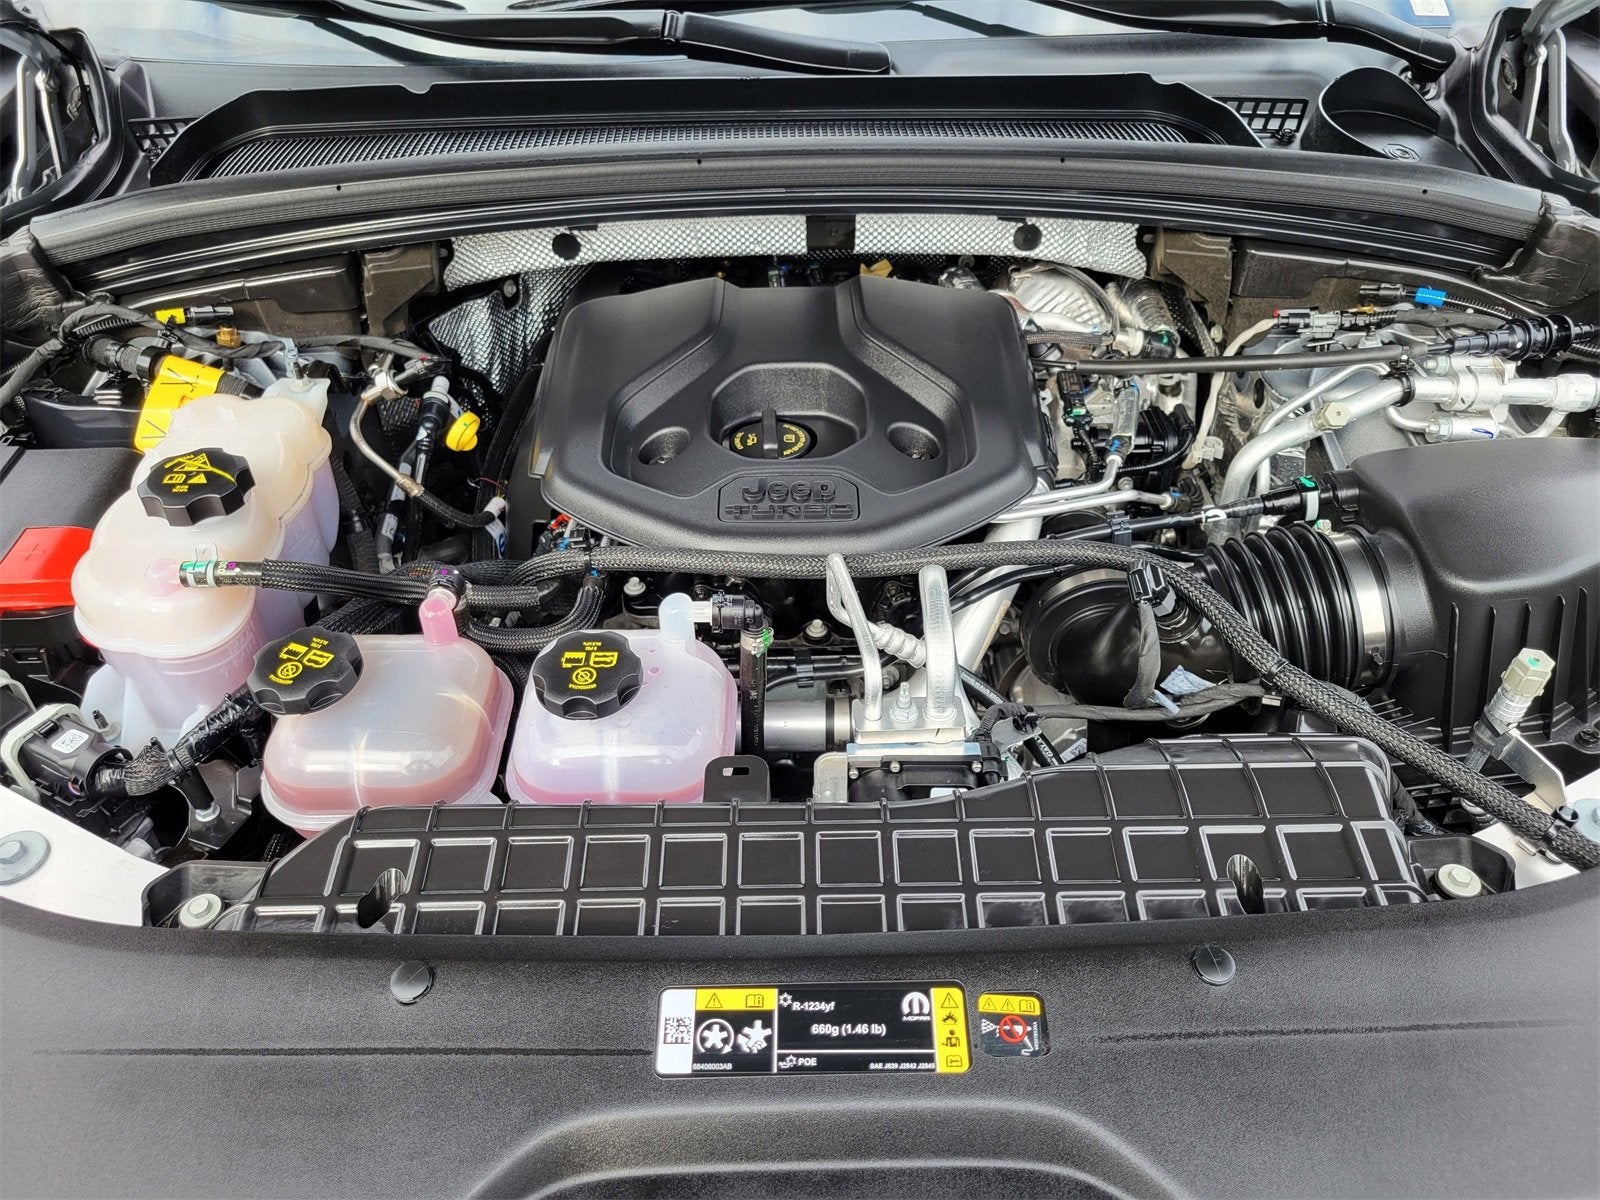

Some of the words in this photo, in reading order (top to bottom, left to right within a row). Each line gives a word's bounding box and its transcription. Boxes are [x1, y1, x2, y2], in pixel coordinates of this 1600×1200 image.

[742, 478, 836, 503] Jeep
[792, 1001, 835, 1012] R-1234yf
[811, 1024, 839, 1037] 660g
[841, 1024, 869, 1037] (1.46
[870, 1024, 887, 1037] lb)
[798, 1057, 817, 1066] POE
